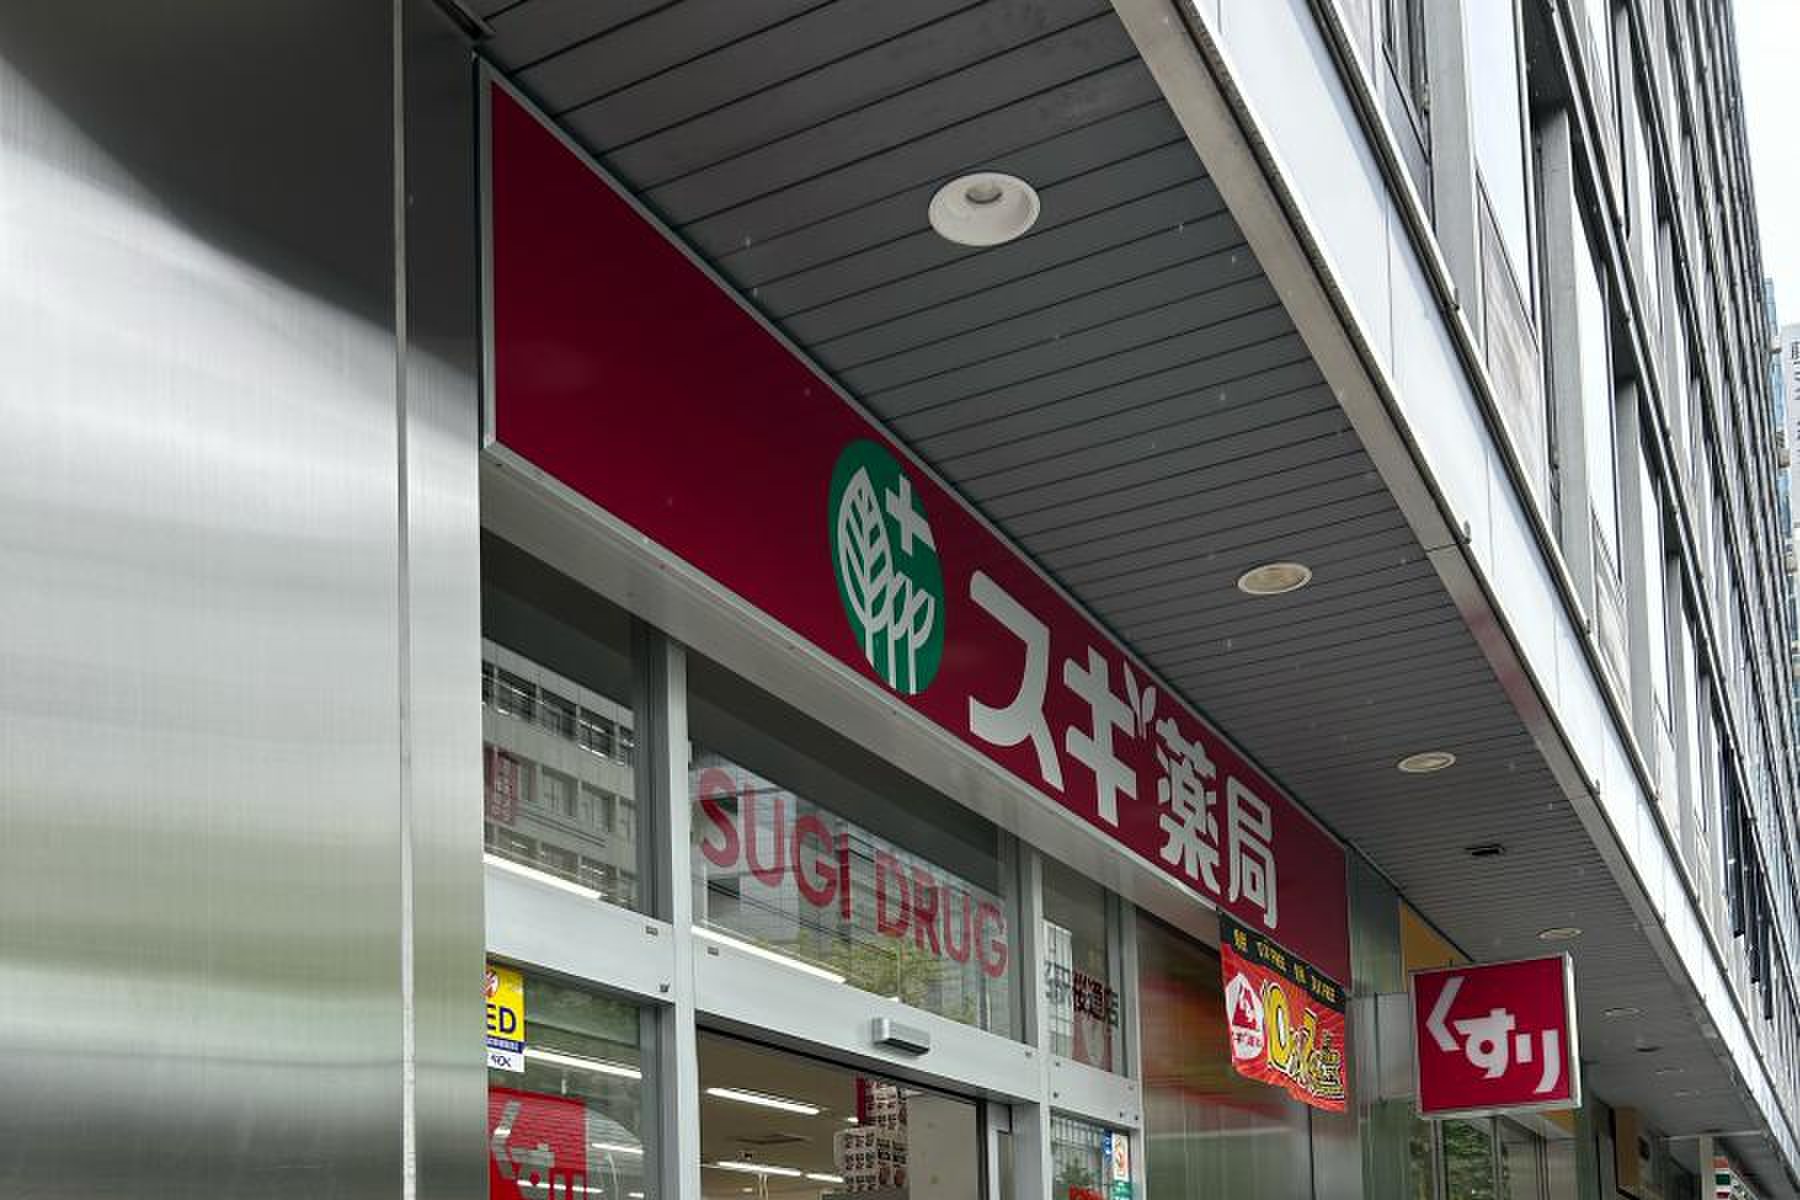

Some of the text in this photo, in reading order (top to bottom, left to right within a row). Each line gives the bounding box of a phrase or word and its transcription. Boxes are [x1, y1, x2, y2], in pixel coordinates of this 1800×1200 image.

[968, 569, 1278, 929] スギ薬局
[697, 766, 1009, 978] SUGI DRUG
[1425, 975, 1560, 1094] くすり
